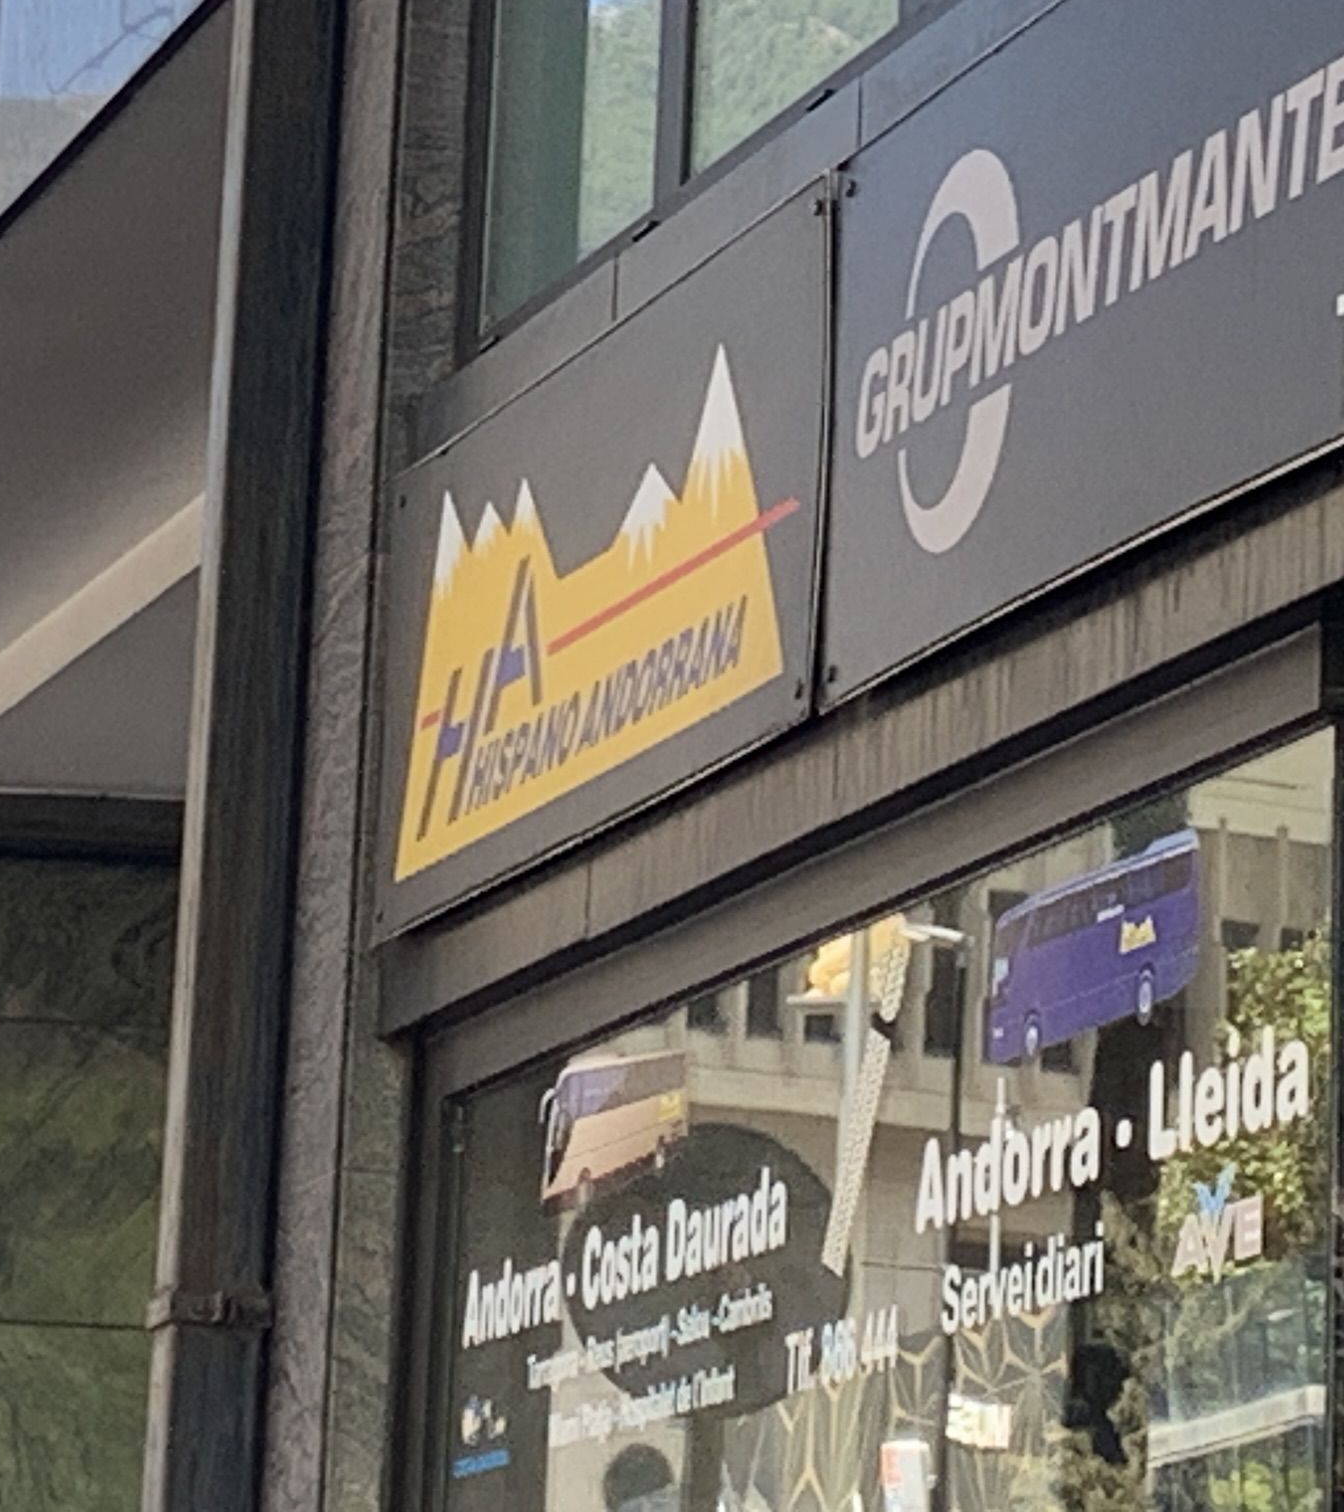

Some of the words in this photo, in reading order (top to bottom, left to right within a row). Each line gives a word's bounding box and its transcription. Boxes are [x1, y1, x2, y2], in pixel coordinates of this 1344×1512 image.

[464, 691, 581, 817] HISPANO
[574, 593, 748, 757] ANDORRANA
[914, 1105, 1102, 1236] Andorra
[1147, 1023, 1309, 1161] Lleida
[1171, 1162, 1264, 1284] AVE
[462, 1256, 561, 1350] Andorra
[581, 1213, 659, 1311] Costa
[664, 1165, 788, 1283] Daurada
